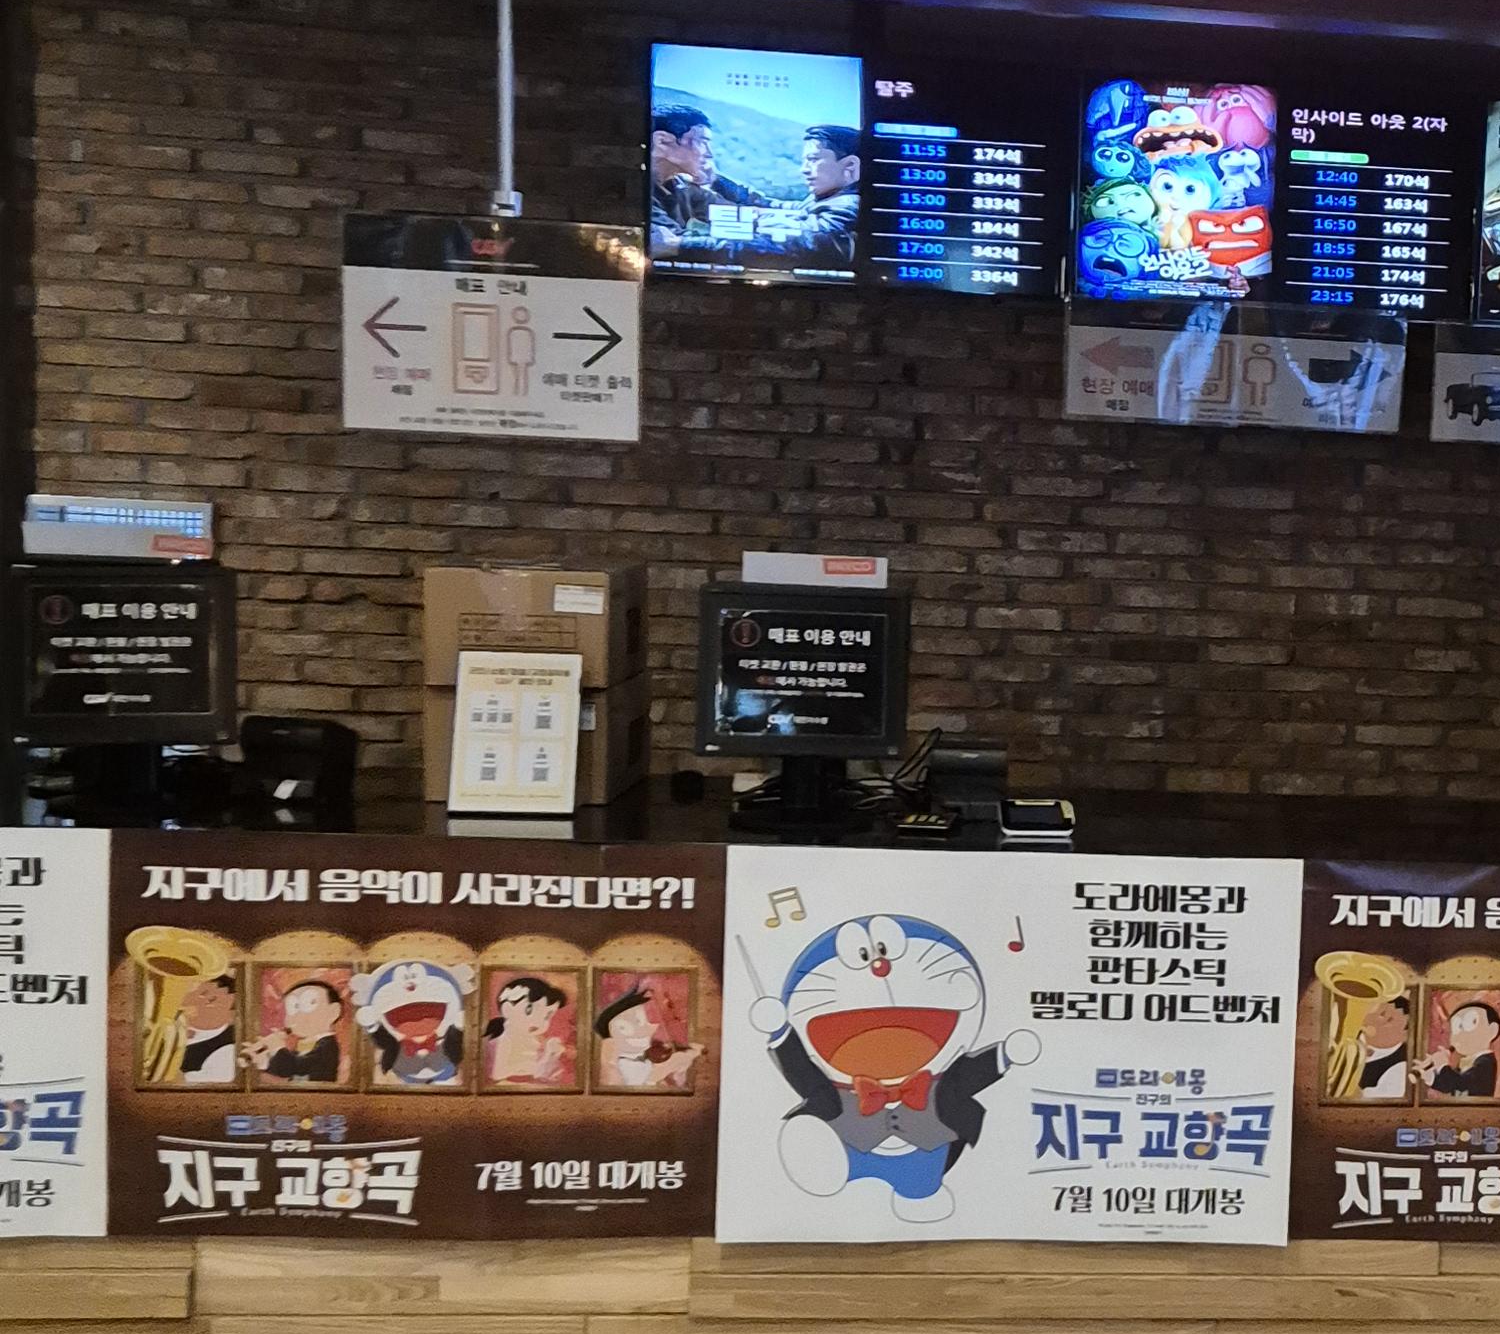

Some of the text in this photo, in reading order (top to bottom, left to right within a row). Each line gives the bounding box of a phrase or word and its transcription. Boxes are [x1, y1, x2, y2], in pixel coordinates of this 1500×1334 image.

[874, 79, 915, 98] 탈주
[1292, 108, 1449, 133] 인사이드 아웃 2(자
[1291, 127, 1316, 143] 막)
[901, 143, 1022, 165] 11:55 174석
[900, 168, 947, 181] 13:00
[1316, 170, 1430, 190] 12:40 170석
[900, 192, 946, 206] 15:00
[1315, 194, 1429, 214] 14:45 163석
[900, 217, 945, 231] 16:00
[1314, 218, 1428, 238] 16:50 167석
[899, 242, 1019, 261] 17:00 342석
[1313, 242, 1427, 262] 18:55 165석
[899, 266, 944, 279] 19:00
[1312, 266, 1426, 285] 21:05 174석
[1310, 290, 1425, 309] 23:15 176석
[803, 628, 836, 646] 이용
[839, 629, 871, 646] 안내
[0, 857, 47, 887] 과
[140, 865, 697, 910] 지구에서 음악이 사라진다면?!
[1072, 881, 1249, 915] 도라에몽과
[1329, 893, 1475, 929] 지구에서
[1088, 918, 1229, 951] 함께하는
[1086, 955, 1227, 987] 판타스틱
[0, 974, 88, 1005] 벤처
[1030, 990, 1281, 1024] 멜로디 어드벤처
[1031, 1102, 1275, 1166] 지구 교향곡
[157, 1149, 423, 1215] 지구 교향곡
[475, 1160, 688, 1192] 7월 10일 대개봉
[1334, 1160, 1424, 1216] 지구
[1053, 1185, 1246, 1215] 7월 10일 대개봉
